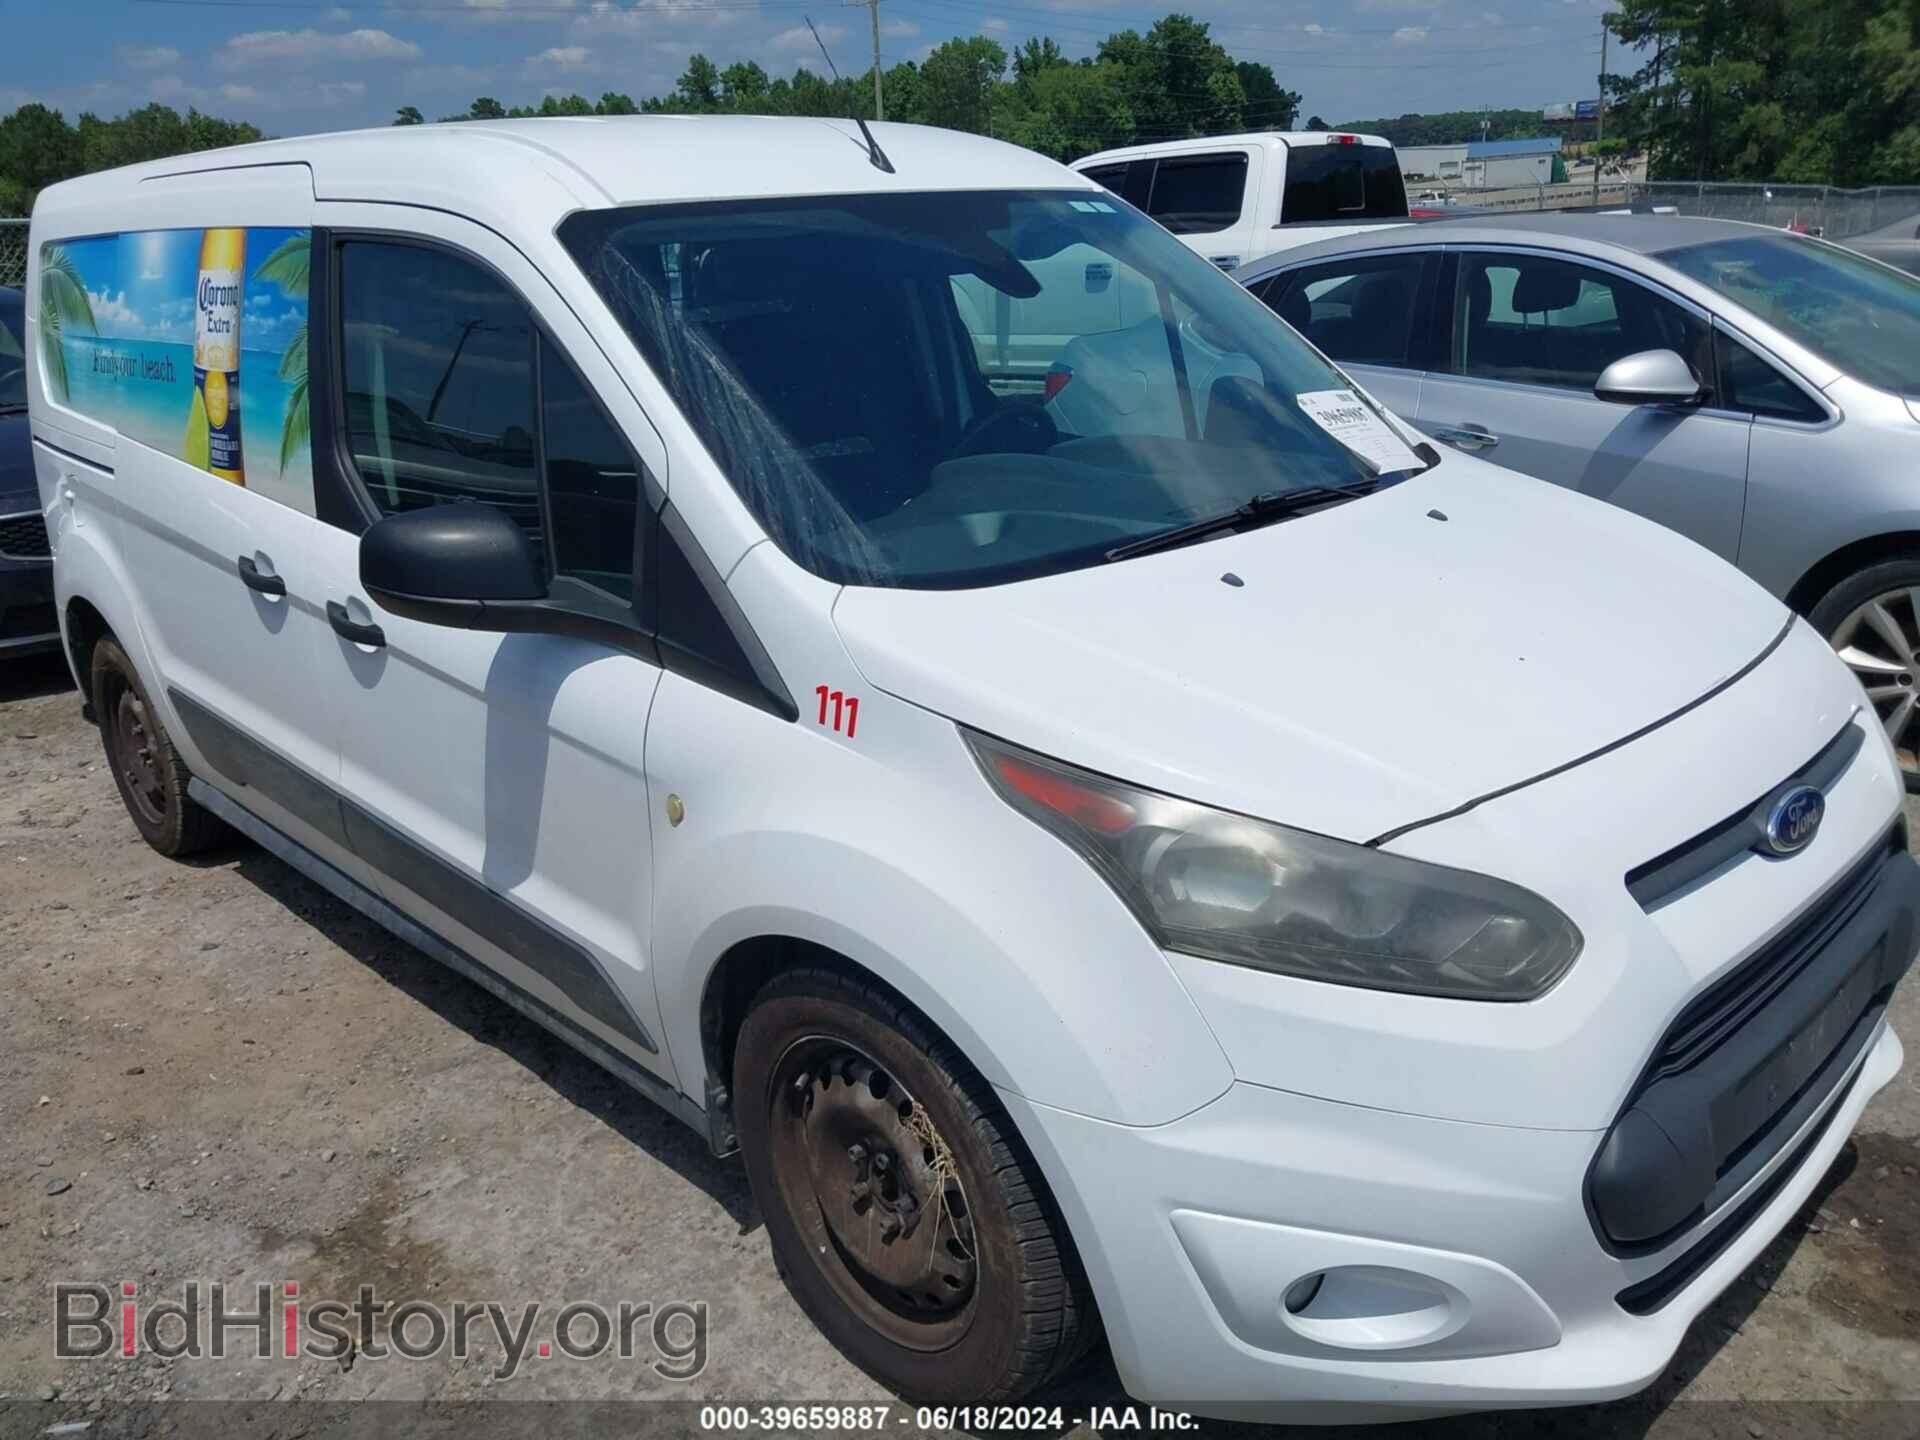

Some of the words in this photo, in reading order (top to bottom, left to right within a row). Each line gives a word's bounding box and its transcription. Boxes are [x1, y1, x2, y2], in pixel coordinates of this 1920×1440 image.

[199, 276, 240, 312] Corona
[207, 310, 231, 333] Extra
[815, 685, 860, 739] 111
[1786, 795, 1819, 840] Ford
